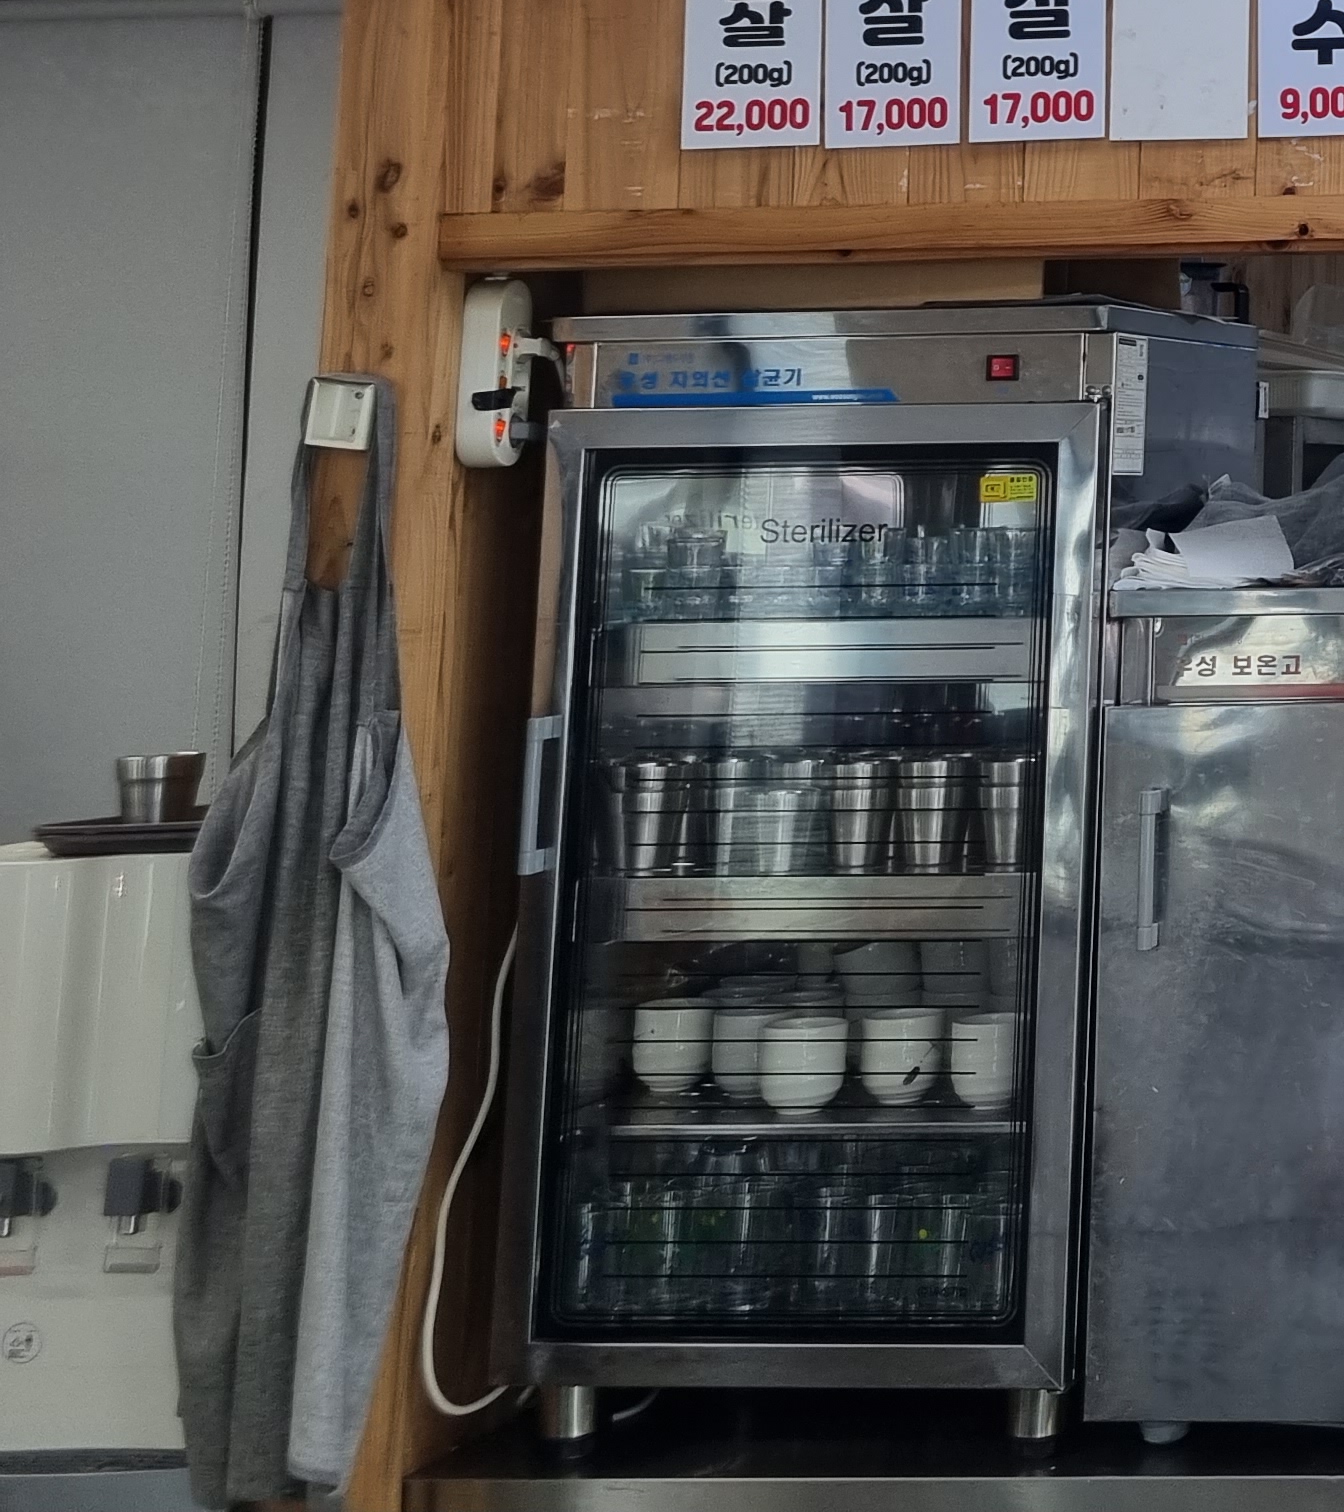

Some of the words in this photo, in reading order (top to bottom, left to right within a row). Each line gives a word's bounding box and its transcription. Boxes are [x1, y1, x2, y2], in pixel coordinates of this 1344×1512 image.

[714, 59, 794, 89] (200g)
[855, 57, 933, 88] (200g)
[1001, 51, 1080, 81] (200g)
[694, 97, 811, 134] 22,000
[840, 96, 949, 133] 17,000
[984, 89, 1095, 126] 17,000
[760, 517, 889, 544] Sterilizer
[1231, 653, 1302, 677] 보온고
